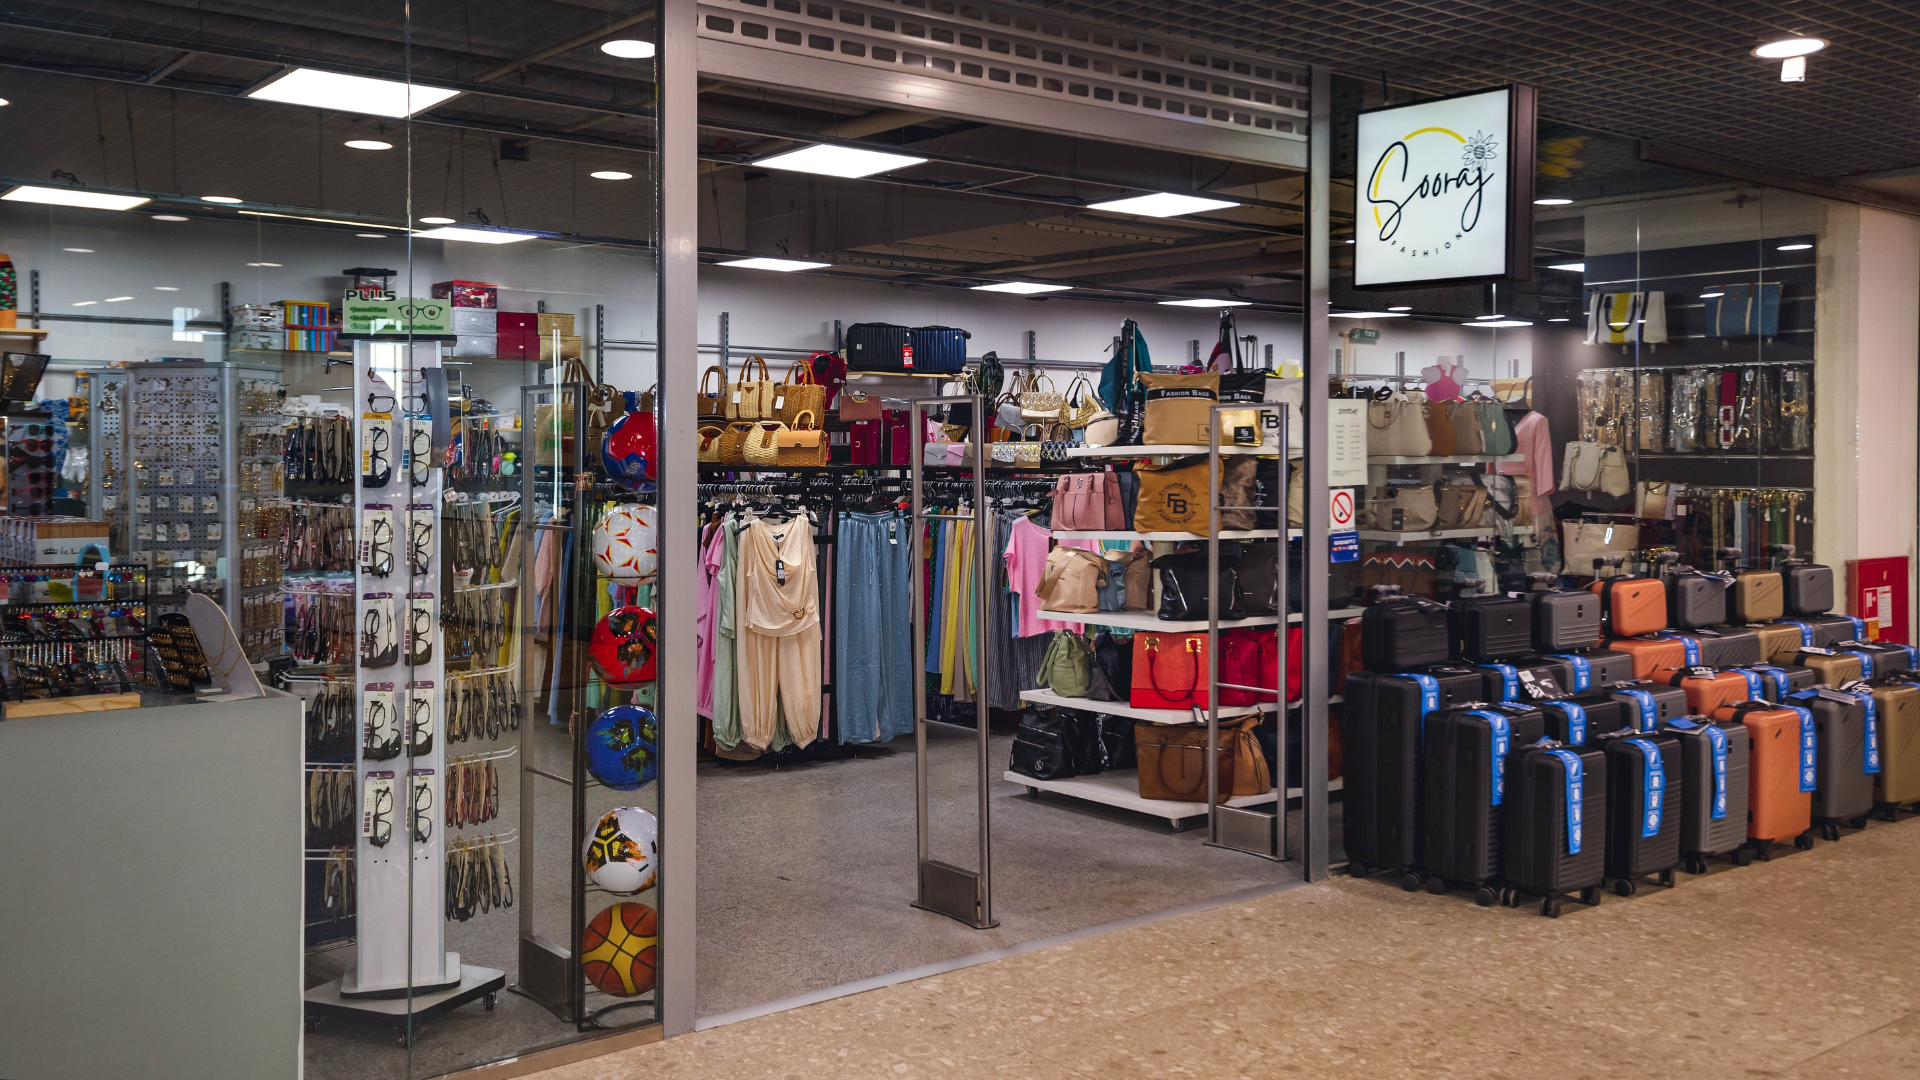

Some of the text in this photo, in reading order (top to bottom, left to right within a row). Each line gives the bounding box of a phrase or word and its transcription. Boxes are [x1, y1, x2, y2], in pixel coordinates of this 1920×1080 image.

[1391, 232, 1463, 258] FASHION
[345, 289, 396, 302] PLUS
[1161, 389, 1210, 397] FASHION BAGS
[1233, 392, 1251, 400] BAGS
[1167, 492, 1188, 515] FB
